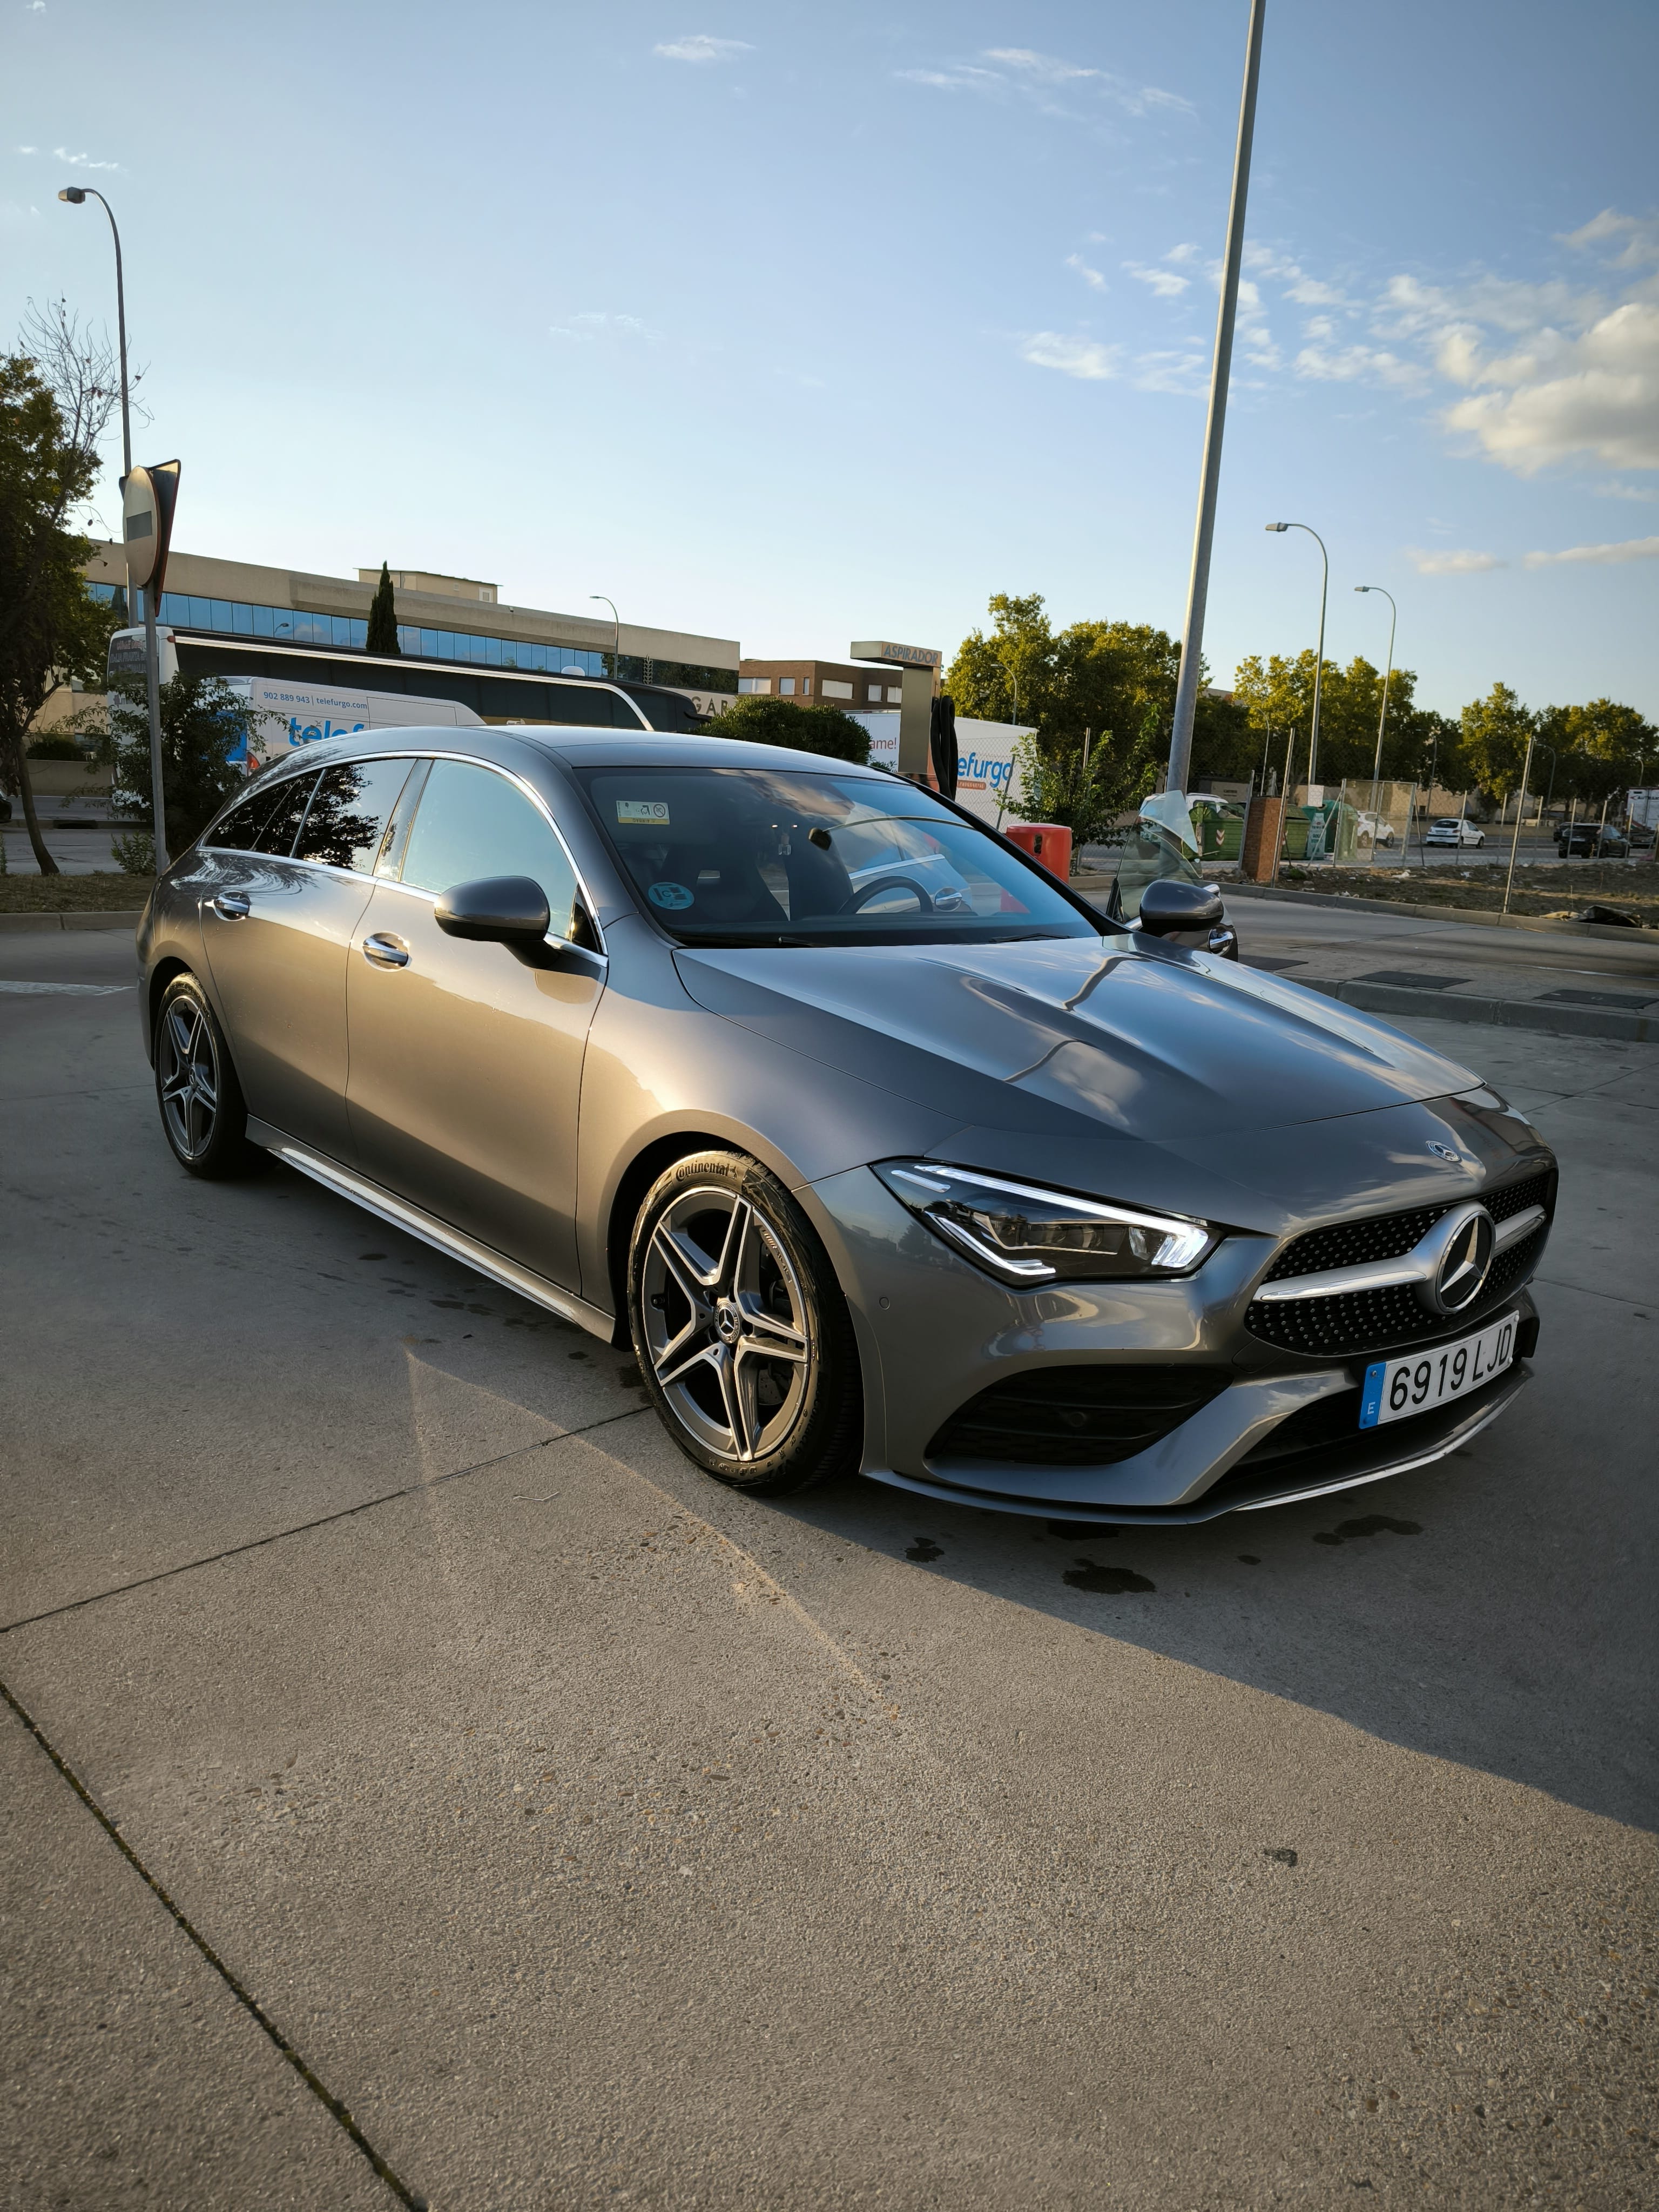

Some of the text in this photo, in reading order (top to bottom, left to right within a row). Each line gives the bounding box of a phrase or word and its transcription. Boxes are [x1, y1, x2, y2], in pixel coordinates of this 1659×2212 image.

[884, 644, 938, 665] ASPIRADOR
[264, 691, 278, 700] 902
[296, 696, 310, 704] 943
[316, 697, 367, 709] telefurgo.com
[676, 1160, 730, 1182] Continental
[1390, 1324, 1512, 1411] 6919 LJD
[1367, 1401, 1375, 1415] E
